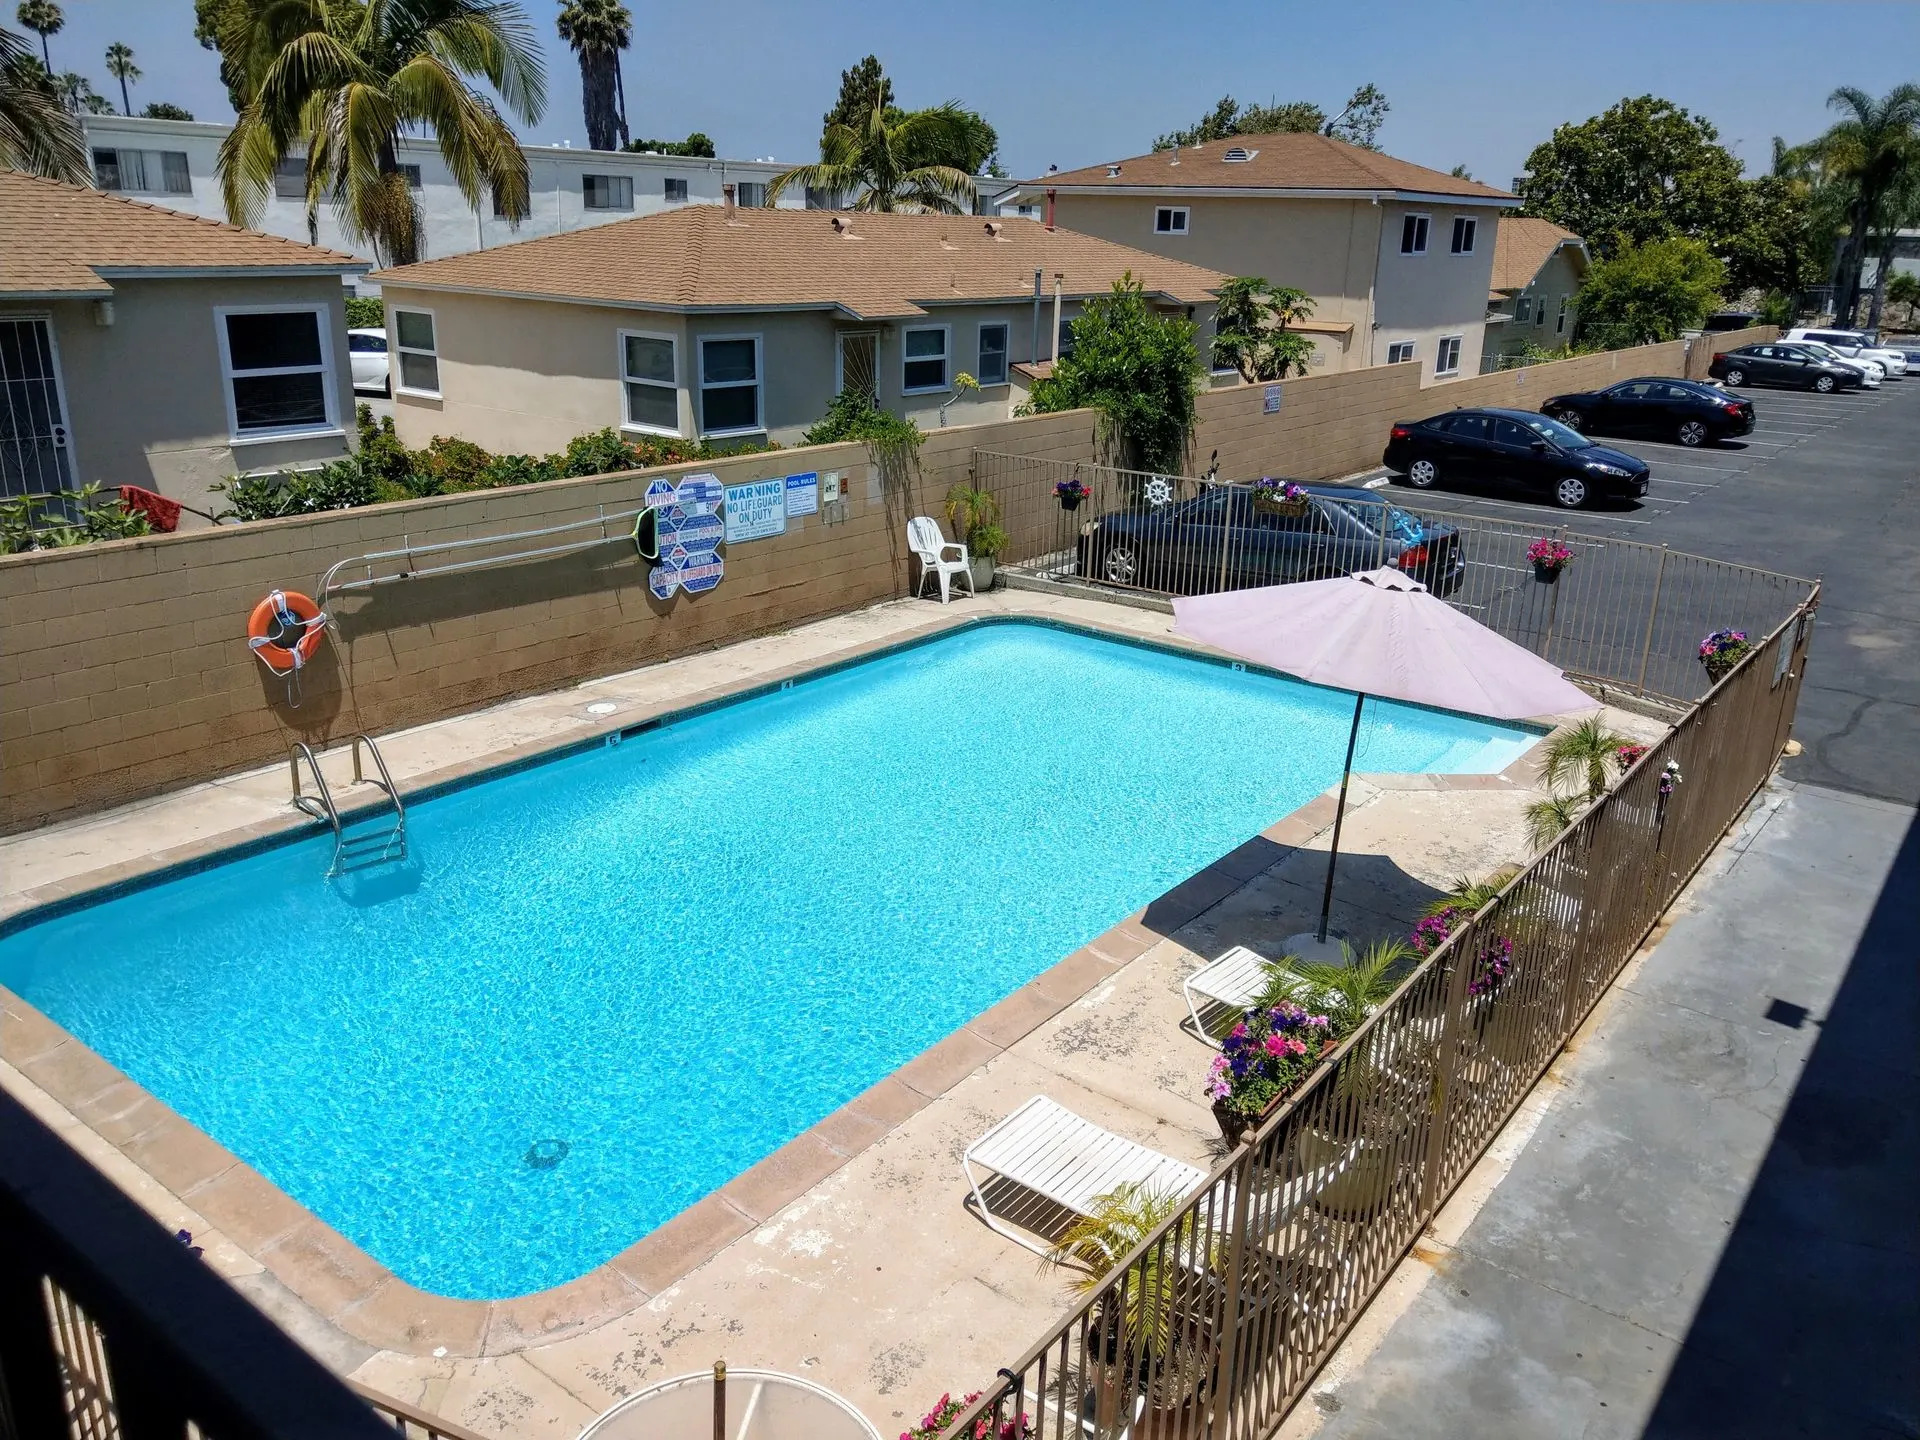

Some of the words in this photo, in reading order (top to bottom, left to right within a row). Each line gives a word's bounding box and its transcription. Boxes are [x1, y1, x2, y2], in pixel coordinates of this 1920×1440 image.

[655, 481, 667, 493] NO
[801, 477, 815, 485] RULES
[647, 492, 676, 506] DIVING
[728, 483, 780, 501] WARNING
[727, 502, 738, 514] NO
[740, 494, 782, 511] LIFEGUARD
[739, 511, 750, 523] ON
[752, 507, 772, 522] DUTY
[658, 533, 677, 546] UTION
[688, 553, 714, 567] WARNING
[651, 572, 678, 586] CAPACITY
